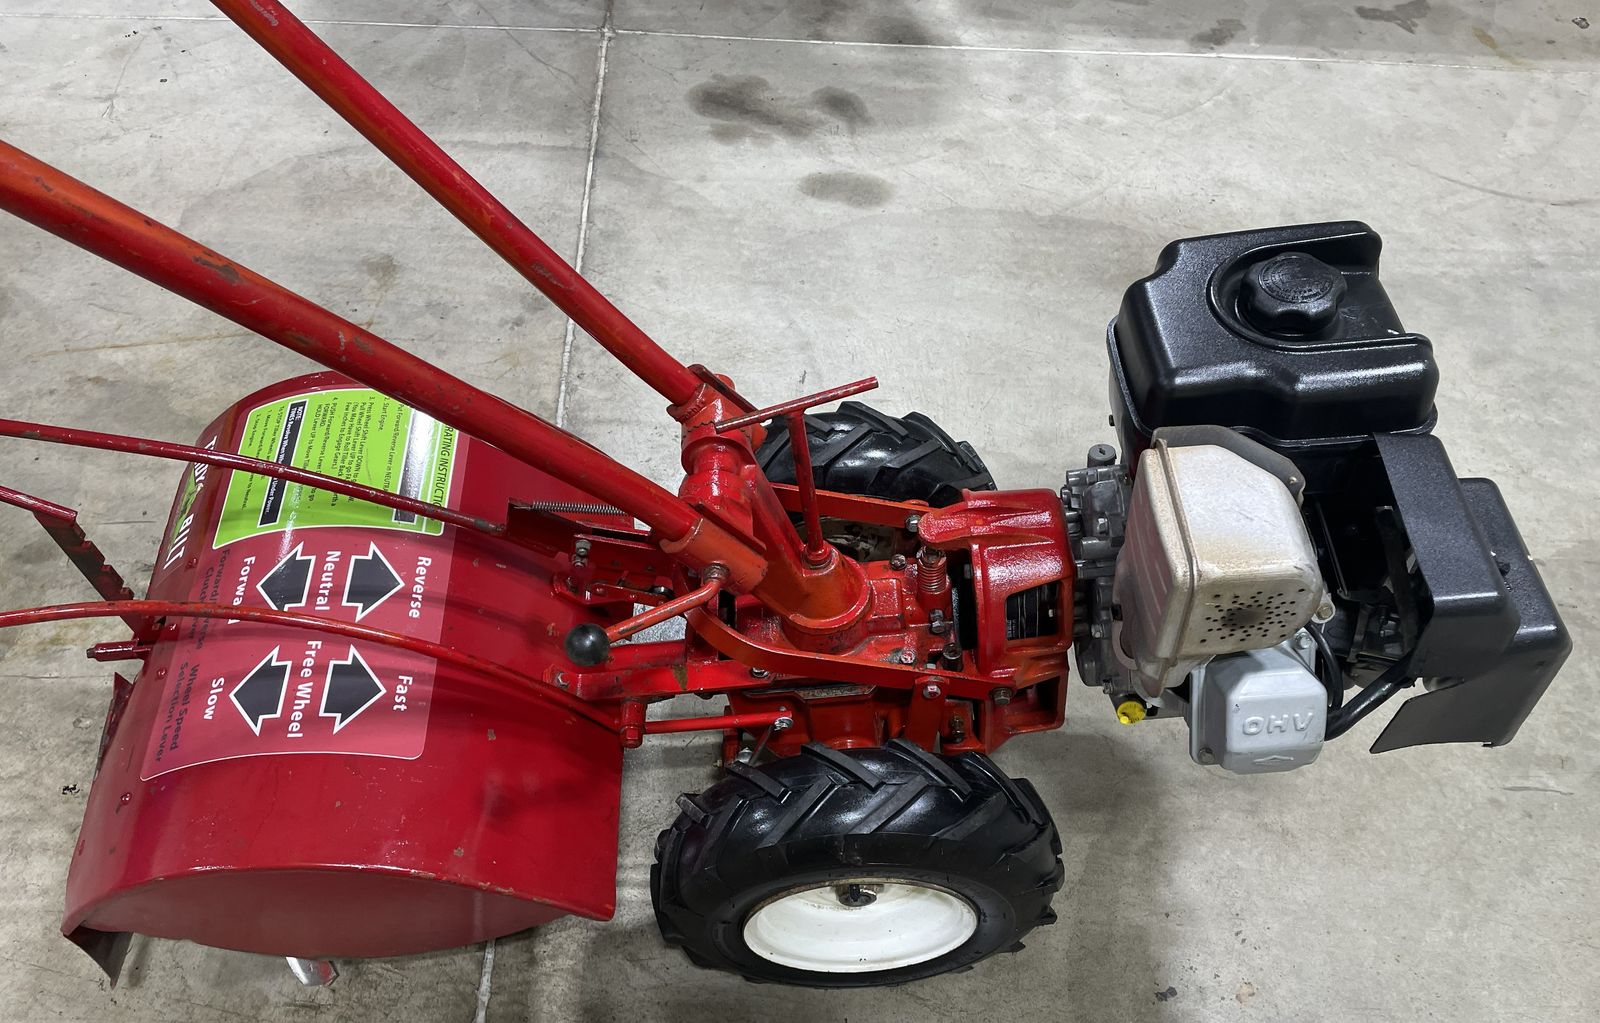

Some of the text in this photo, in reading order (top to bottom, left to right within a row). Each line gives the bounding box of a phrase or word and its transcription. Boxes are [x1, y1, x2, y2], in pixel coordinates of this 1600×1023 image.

[289, 407, 297, 421] TINES
[295, 406, 303, 420] NOTE:
[315, 403, 323, 418] HOLD
[329, 402, 337, 416] PUSH
[366, 402, 374, 414] Press
[341, 412, 349, 427] Inches
[356, 412, 364, 425] Wheel
[363, 415, 372, 428] Wheel
[377, 415, 387, 431] Engine.
[284, 421, 294, 440] Revolve
[320, 416, 334, 456] Forward/Reverse
[361, 429, 369, 440] Shift
[280, 440, 289, 454] When
[335, 434, 344, 451] Engage
[351, 438, 359, 451] Lever
[358, 442, 366, 454] Lever
[441, 426, 454, 457] RATING
[305, 445, 313, 459] Move
[340, 452, 348, 464] Tiller
[387, 452, 396, 465] Lever
[317, 456, 325, 470] Lever
[354, 456, 363, 472] DOWN
[269, 481, 278, 497] Under
[382, 472, 392, 491] NEUTRA
[308, 494, 314, 502] go
[315, 551, 341, 611] Neutral
[409, 556, 432, 618] Reverse
[287, 641, 322, 738] Free Wheel
[393, 675, 413, 712] Fast
[203, 677, 225, 720] Slow
[156, 661, 189, 763] Selection Lever
[169, 664, 200, 751] Wheel Speed
[1242, 712, 1314, 735] OHV
